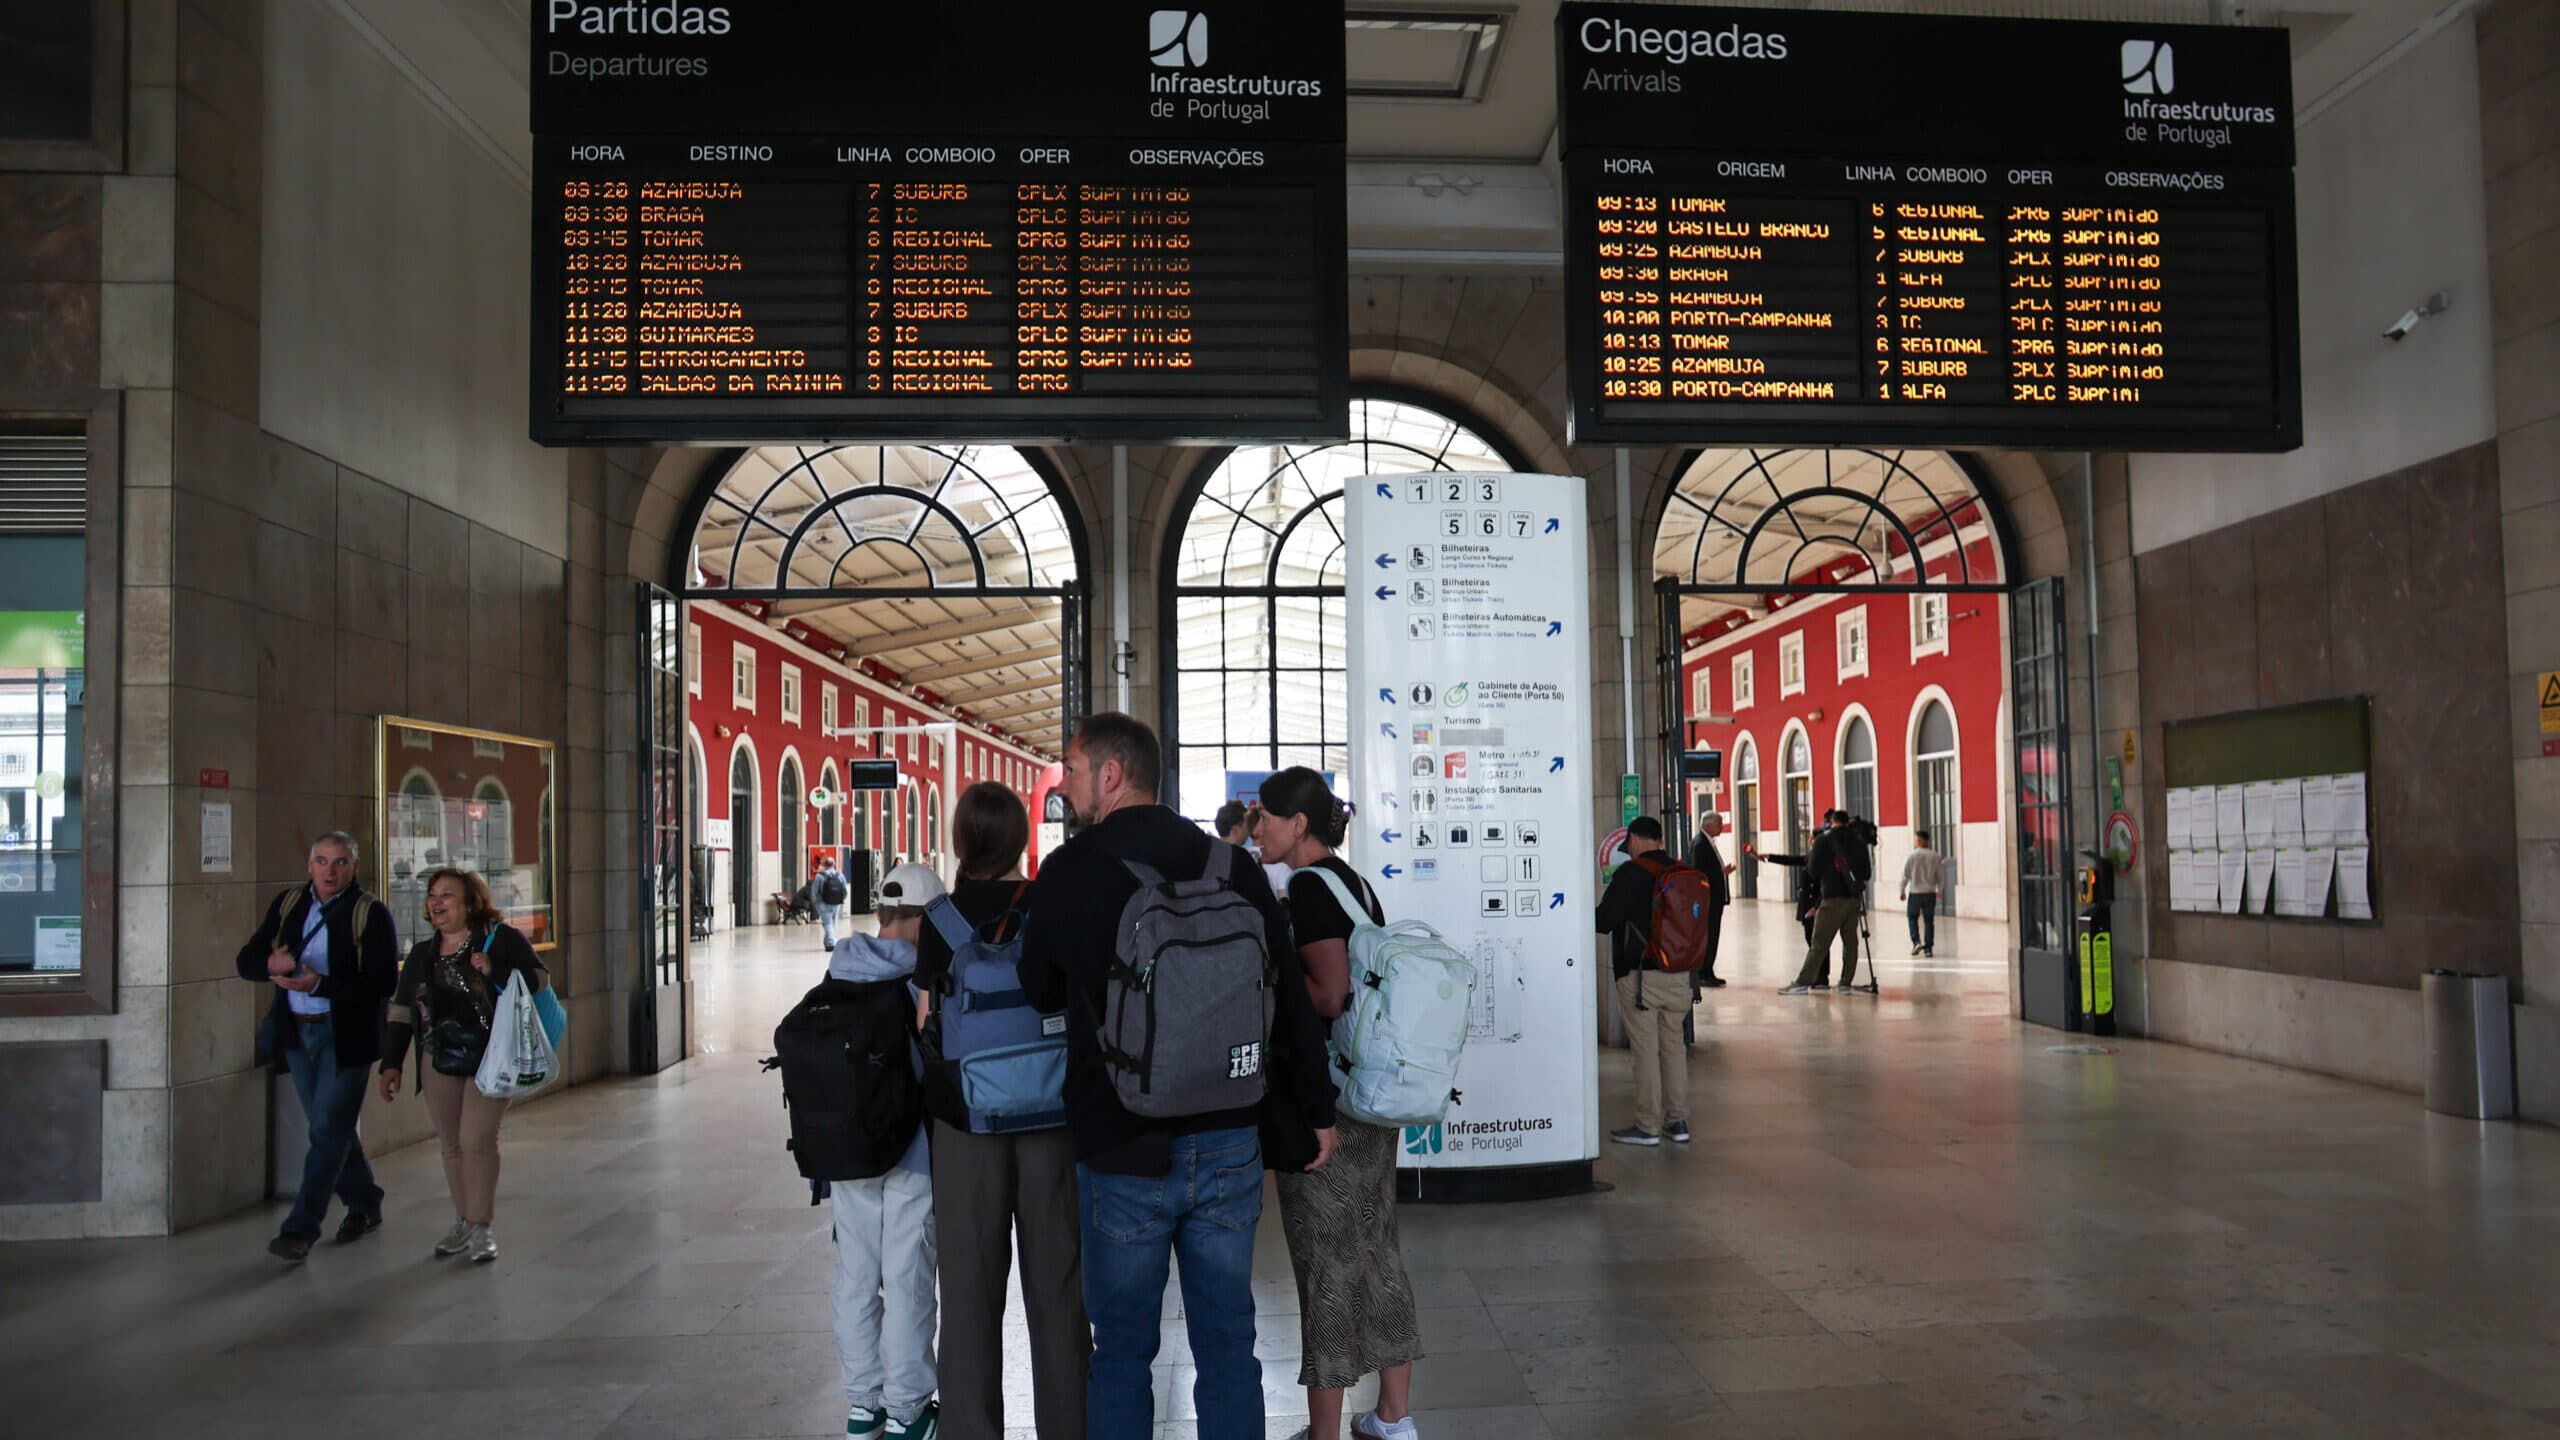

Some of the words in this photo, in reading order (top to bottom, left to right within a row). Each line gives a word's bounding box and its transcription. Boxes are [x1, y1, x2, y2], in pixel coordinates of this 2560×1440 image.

[550, 0, 730, 34] Partidas
[1581, 18, 1787, 63] Chegadas
[550, 51, 707, 80] Departures
[1151, 73, 1320, 96] Infraestruturas
[1584, 69, 1681, 92] Arrivals
[1151, 98, 1174, 117] de
[1188, 99, 1269, 123] Portugal
[2125, 99, 2274, 125] Infraestruturas
[2126, 123, 2146, 140] de
[2159, 124, 2230, 147] Portugal
[572, 146, 624, 160] HORA
[691, 146, 772, 160] DESTINO
[838, 148, 891, 161] LINHA
[906, 148, 995, 162] COMBOIO
[1020, 149, 1069, 163] OPER
[1130, 149, 1263, 168] OBSERVAÇÕES
[1605, 159, 1653, 173] HORA
[1718, 162, 1784, 177] ORIGEM
[1846, 166, 1895, 180] LINHA
[1907, 167, 1986, 183] COMBOIO
[2008, 170, 2052, 184] OPER
[2106, 172, 2223, 190] OBSERVAÇÕES
[869, 184, 880, 199] 7
[1598, 196, 1657, 211] 09:13
[1671, 198, 1726, 212] TOMAR
[1599, 220, 1657, 235] 09:20
[1668, 221, 1750, 236] CASTELO
[1760, 224, 1829, 238] BRANCO
[1600, 243, 1658, 258] 09:25
[1669, 245, 1761, 260] AZAMBUJA
[868, 255, 880, 270] 7
[1600, 267, 1659, 280] 09:30
[1670, 269, 1728, 282] BRAGA
[1600, 291, 1659, 304] 09:55
[1670, 292, 1762, 305] AZAMBUJA
[868, 302, 880, 318] 7
[1603, 310, 1660, 325] 10:00
[1671, 313, 1832, 327] PORTO-CAMPANHÃ
[1604, 333, 1660, 349] 10:13
[1672, 335, 1729, 350] TOMAR
[1876, 337, 1888, 352] 6
[1604, 357, 1661, 373] 10:25
[1672, 358, 1764, 374] AZAMBUJA
[1877, 360, 1889, 375] 7
[1604, 380, 1662, 397] 10:30
[1672, 383, 1834, 399] PORTO-CAMPANHÃ
[1880, 384, 1890, 399] 1
[1415, 485, 1424, 500] 1
[1448, 484, 1460, 500] 2
[1482, 484, 1493, 500] 3
[1449, 519, 1460, 534] 5
[1483, 518, 1494, 534] 6
[1516, 521, 1526, 536] 7
[1441, 544, 1490, 552] Bilheteiras
[1441, 578, 1490, 586] Bilheteiras
[1442, 613, 1490, 621] Bilheteiras
[1492, 612, 1546, 622] Automáticas
[1478, 682, 1518, 690] Gabinete
[1520, 682, 1530, 690] de
[1532, 682, 1558, 691] Apoio
[1492, 691, 1522, 699] Cliente
[1524, 692, 1550, 701] (Porta
[1444, 716, 1481, 724] Turismo
[1498, 785, 1542, 794] Sanitarias
[1241, 1042, 1260, 1056] PE
[1231, 1054, 1259, 1069] TER
[1229, 1064, 1258, 1078] SON
[1447, 1116, 1552, 1136] Infraestruturas
[1448, 1138, 1464, 1152] de
[1471, 1136, 1523, 1152] Portugal
